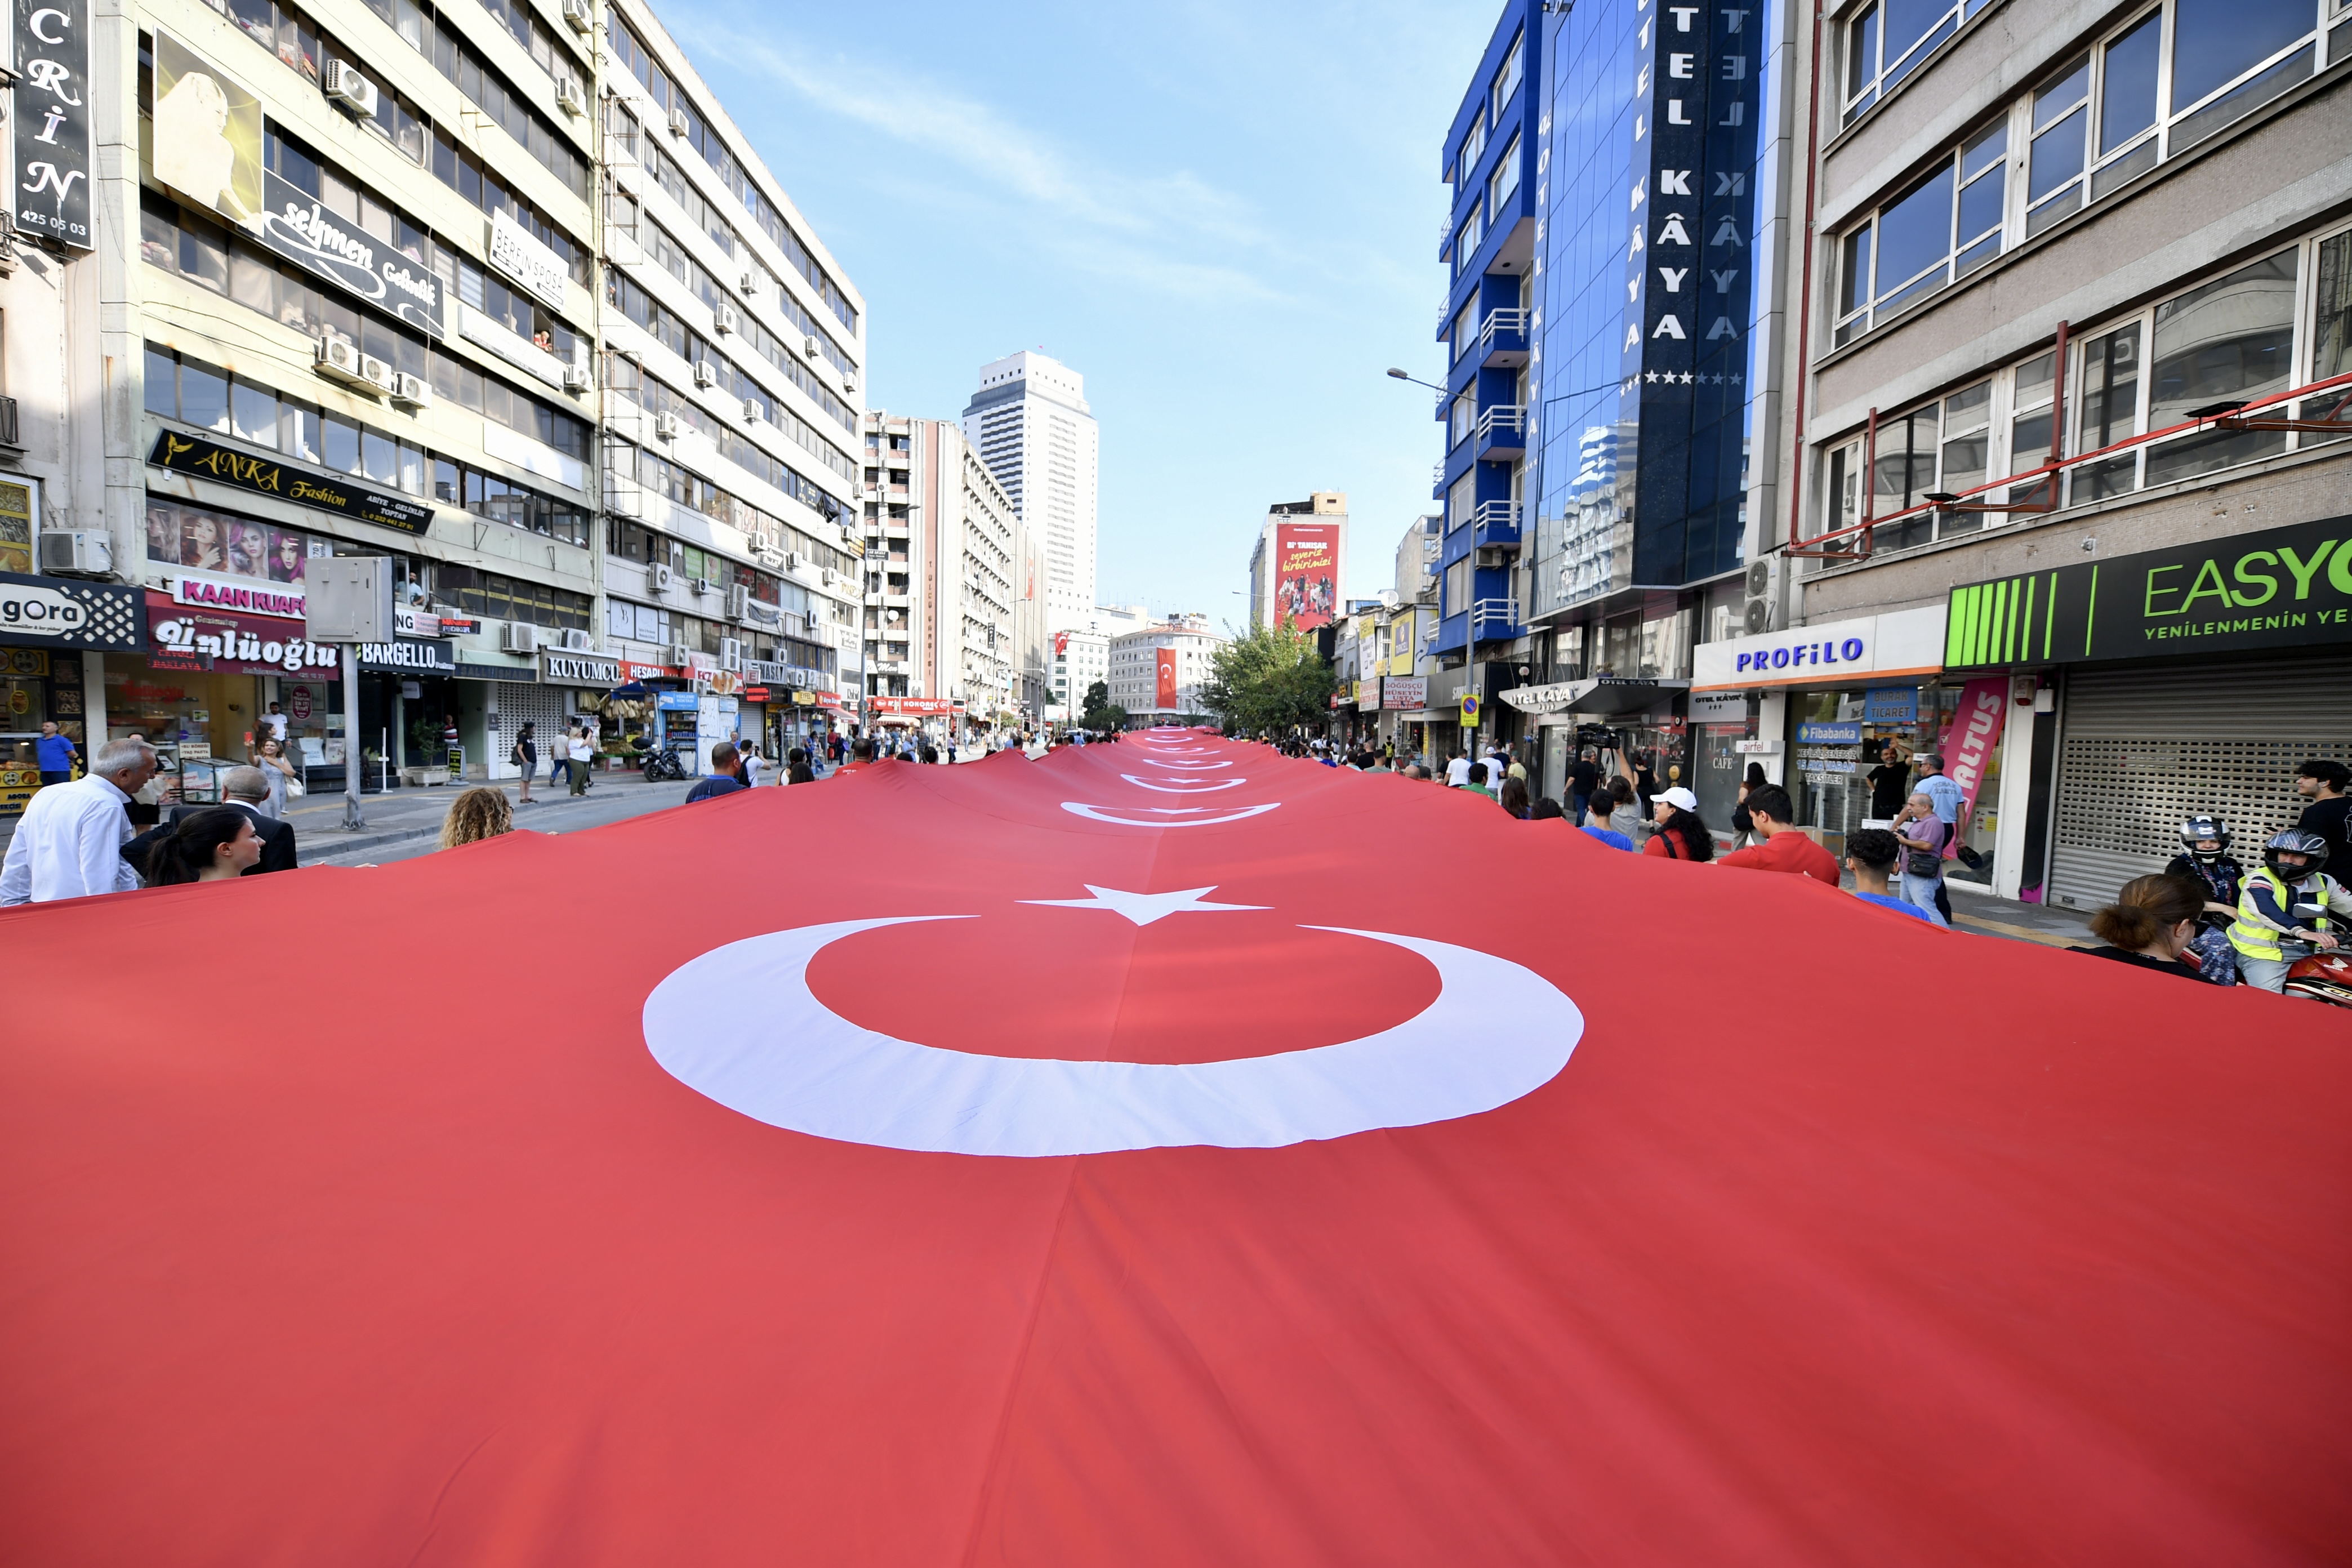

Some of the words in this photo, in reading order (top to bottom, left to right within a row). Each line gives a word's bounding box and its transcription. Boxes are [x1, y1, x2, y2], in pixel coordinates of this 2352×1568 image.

[21, 210, 47, 225] 425
[50, 219, 66, 230] 05
[70, 222, 86, 236] 03
[1624, 175, 1646, 353] KÂYA
[1652, 169, 1692, 340] KÂYA
[534, 262, 563, 294] SPOSA
[194, 449, 279, 492] ANKA
[289, 480, 346, 507] Fashion
[366, 495, 389, 507] ABİYE
[395, 502, 426, 518] GELİNLİK
[380, 507, 407, 521] TOPTAN
[1282, 556, 1332, 572] birbirimizi
[1290, 549, 1323, 560] severiz
[184, 581, 250, 607] KAAN
[2145, 611, 2306, 640] YENİLENMENİN
[2317, 609, 2352, 625] YE
[362, 643, 435, 669] BARGELLO
[547, 657, 620, 683] KUYUMCU
[1386, 682, 1423, 691] SÖĞÜŞÇÜ
[1874, 691, 1909, 702] BURAK
[1870, 705, 1910, 718] TİCARET
[1810, 727, 1856, 740] Fibabanka
[1953, 691, 2002, 790] ALTUS
[1744, 741, 1763, 752] airfel
[1797, 747, 1824, 759] KEFİLSİZ
[1824, 749, 1857, 760] SENETSİZ
[1797, 759, 1807, 769] 15
[1807, 760, 1824, 771] AYA
[1825, 761, 1857, 773] VARAN
[1805, 772, 1844, 785] TAKSİTLER
